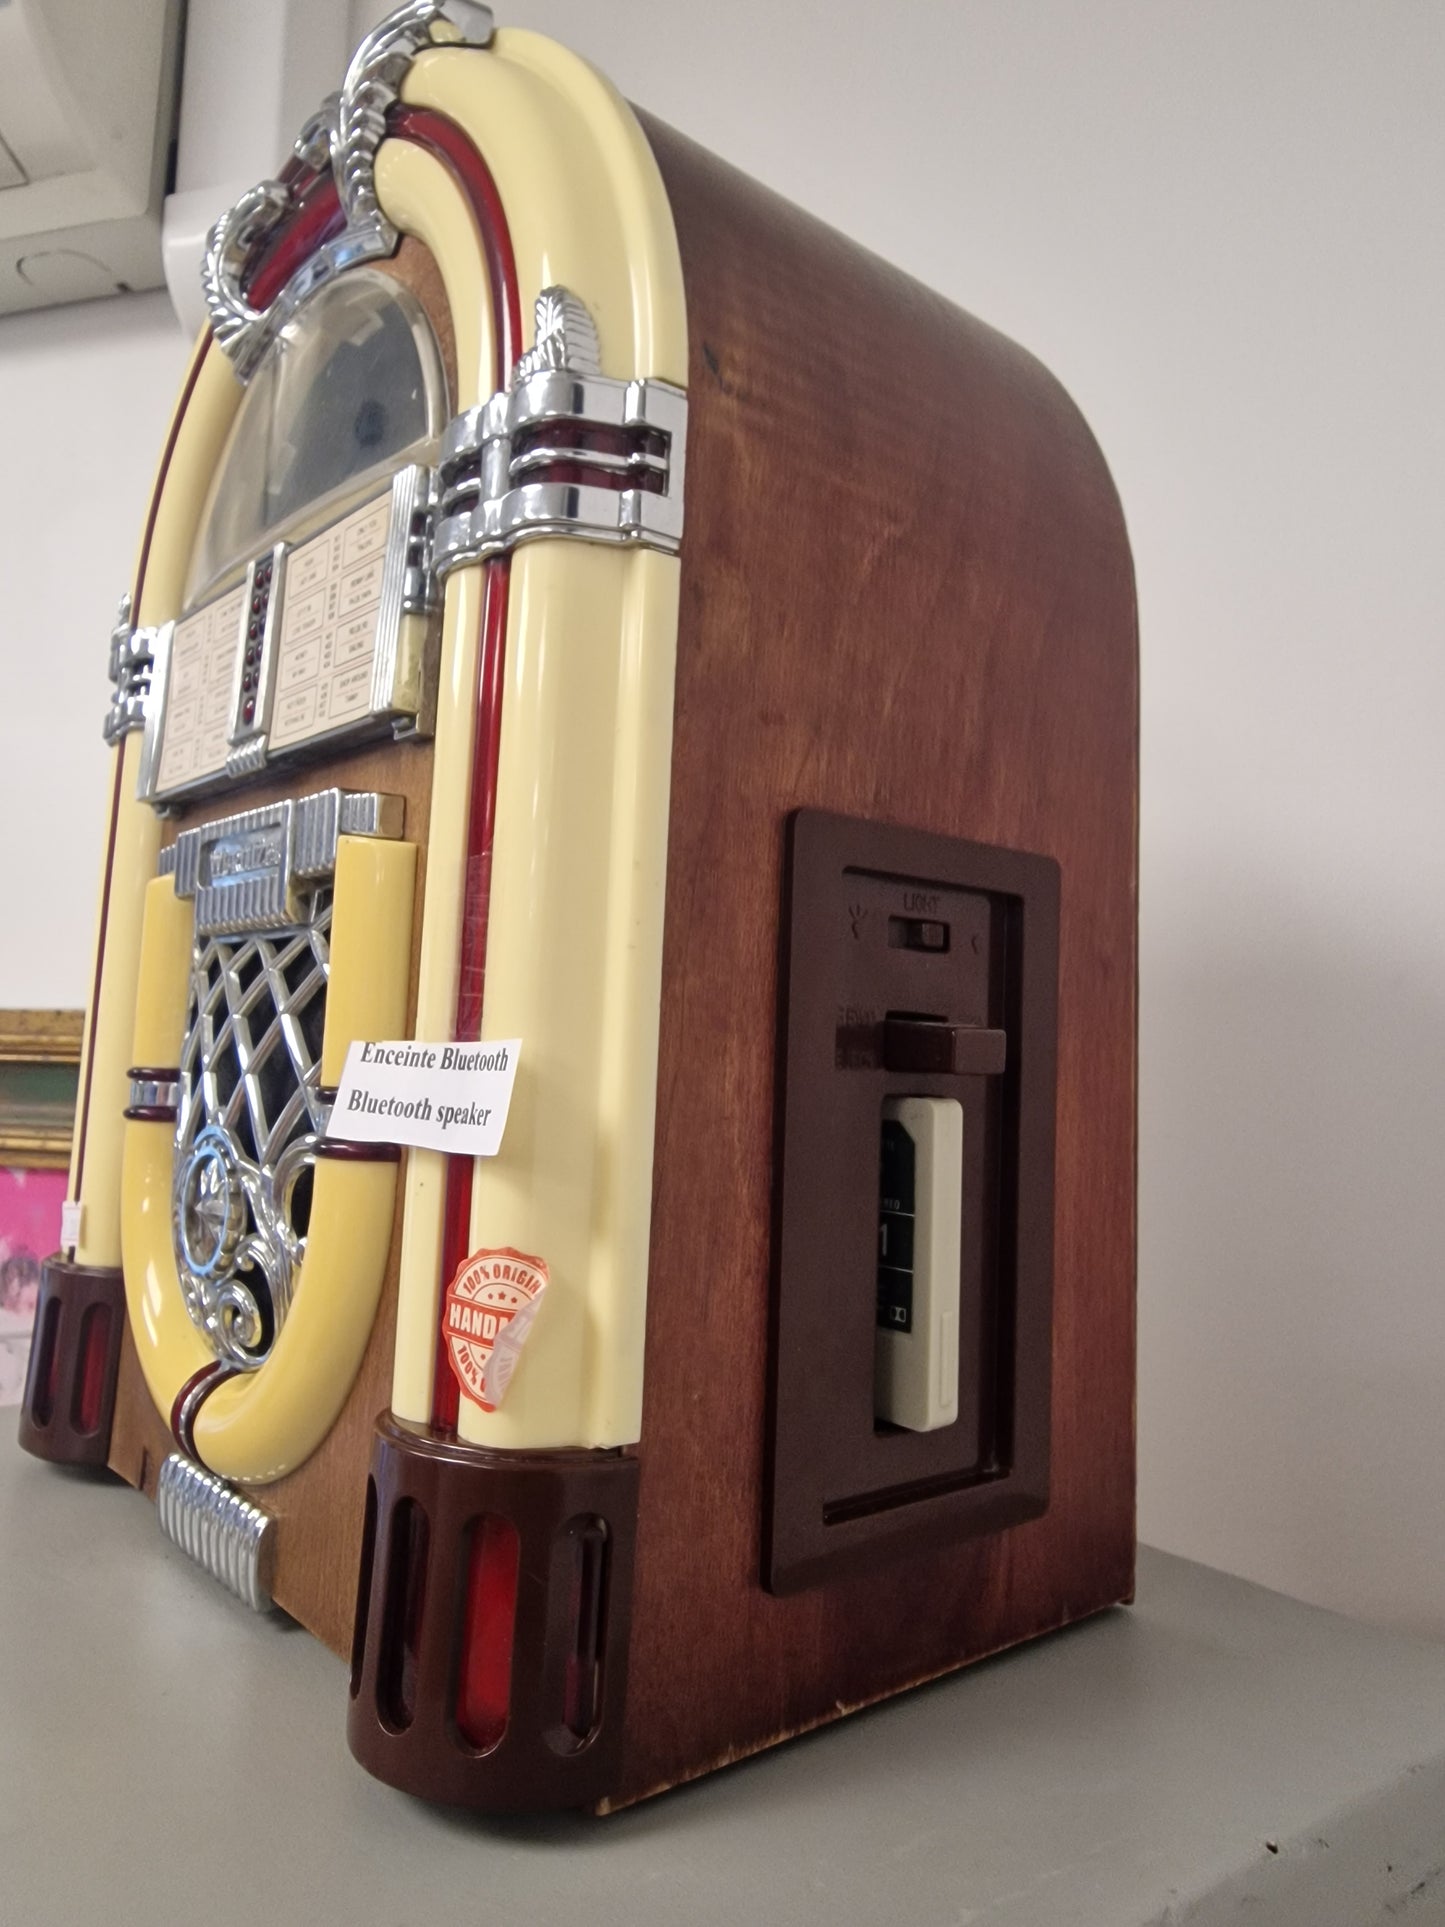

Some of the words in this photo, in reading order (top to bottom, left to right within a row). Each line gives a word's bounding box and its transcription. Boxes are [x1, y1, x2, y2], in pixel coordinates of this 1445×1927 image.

[360, 1041, 436, 1069] Enceinte
[440, 1047, 509, 1072] Bluetooth
[346, 1089, 433, 1121] Bluetooth
[436, 1101, 492, 1130] speaker
[463, 1265, 490, 1295] 100%
[493, 1264, 542, 1295] ORIGIN
[449, 1303, 511, 1340] HAND
[457, 1345, 478, 1386] 100%
